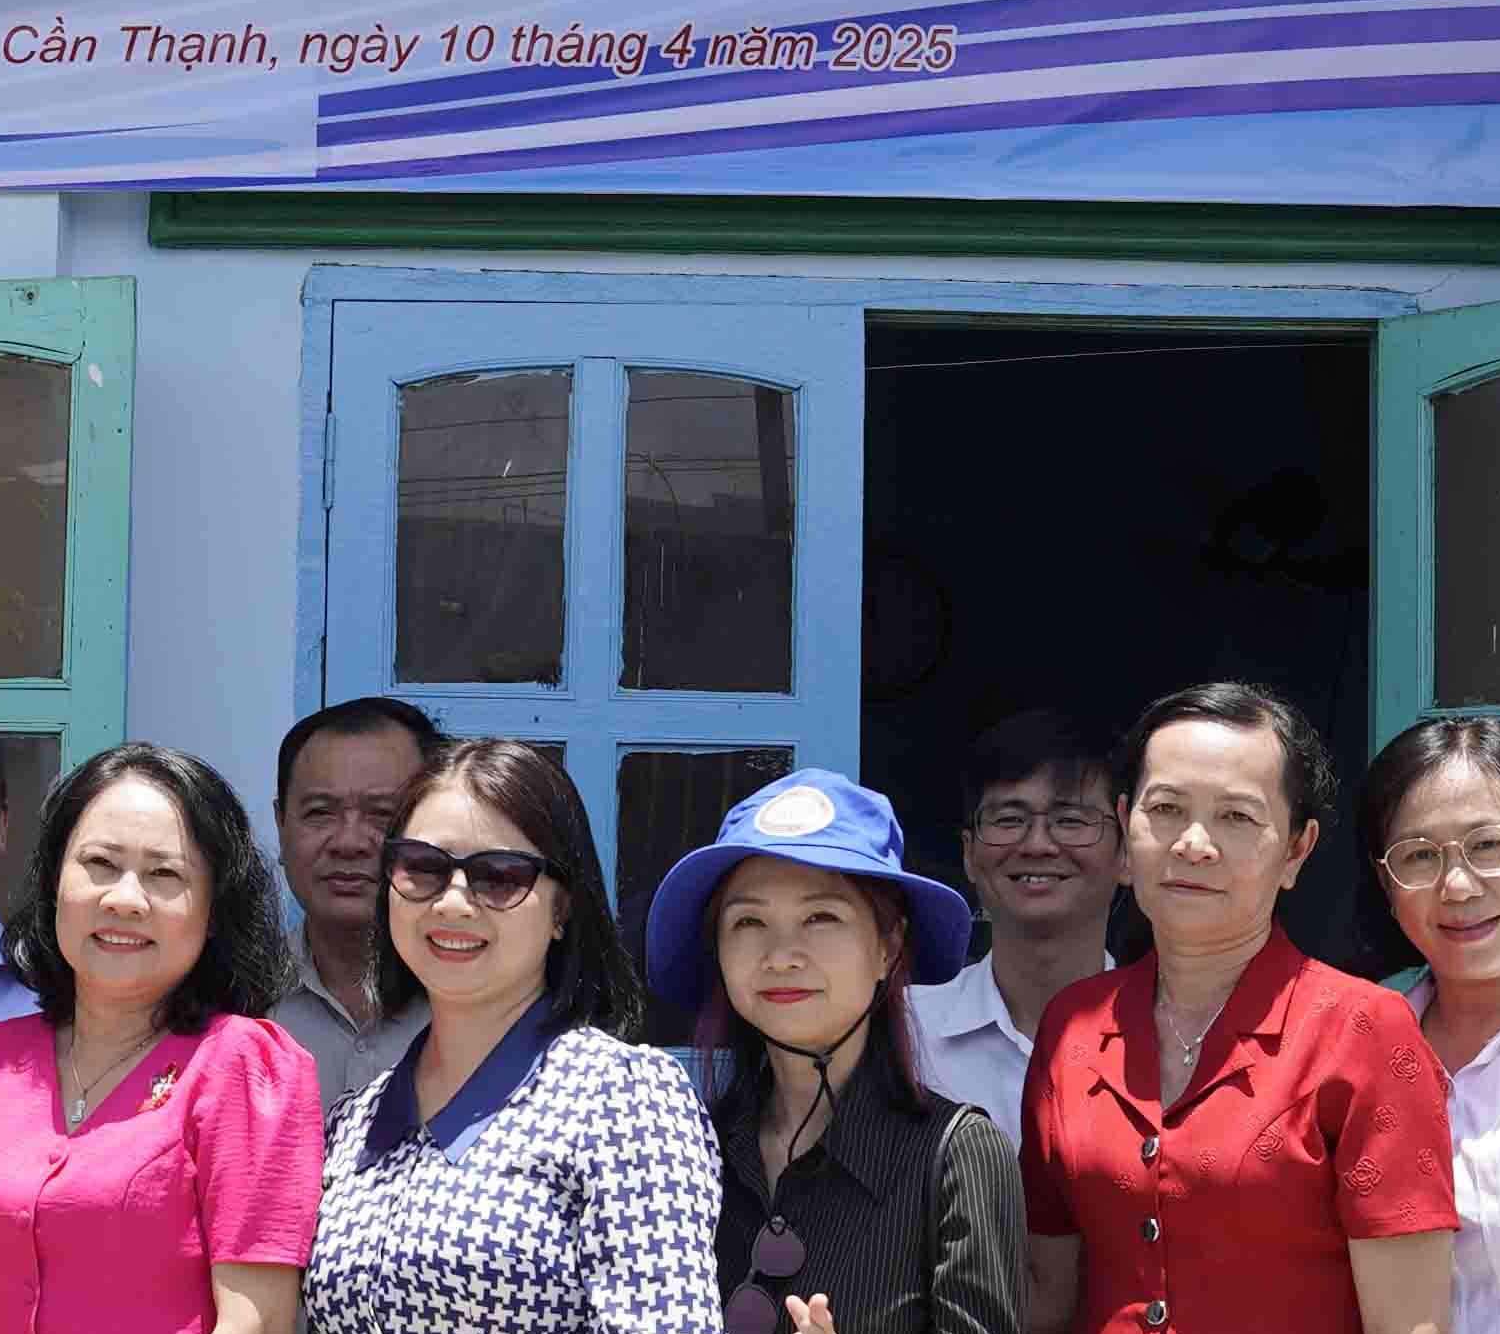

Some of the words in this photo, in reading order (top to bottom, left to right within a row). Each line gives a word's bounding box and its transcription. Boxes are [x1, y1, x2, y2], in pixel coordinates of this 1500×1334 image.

[1, 15, 99, 65] Cần
[120, 21, 279, 69] Thạnh,
[300, 25, 419, 73] ngày
[439, 27, 494, 63] 10
[512, 24, 651, 74] tháng
[661, 24, 694, 66] 4
[709, 30, 815, 68] năm
[831, 24, 955, 69] 2025
